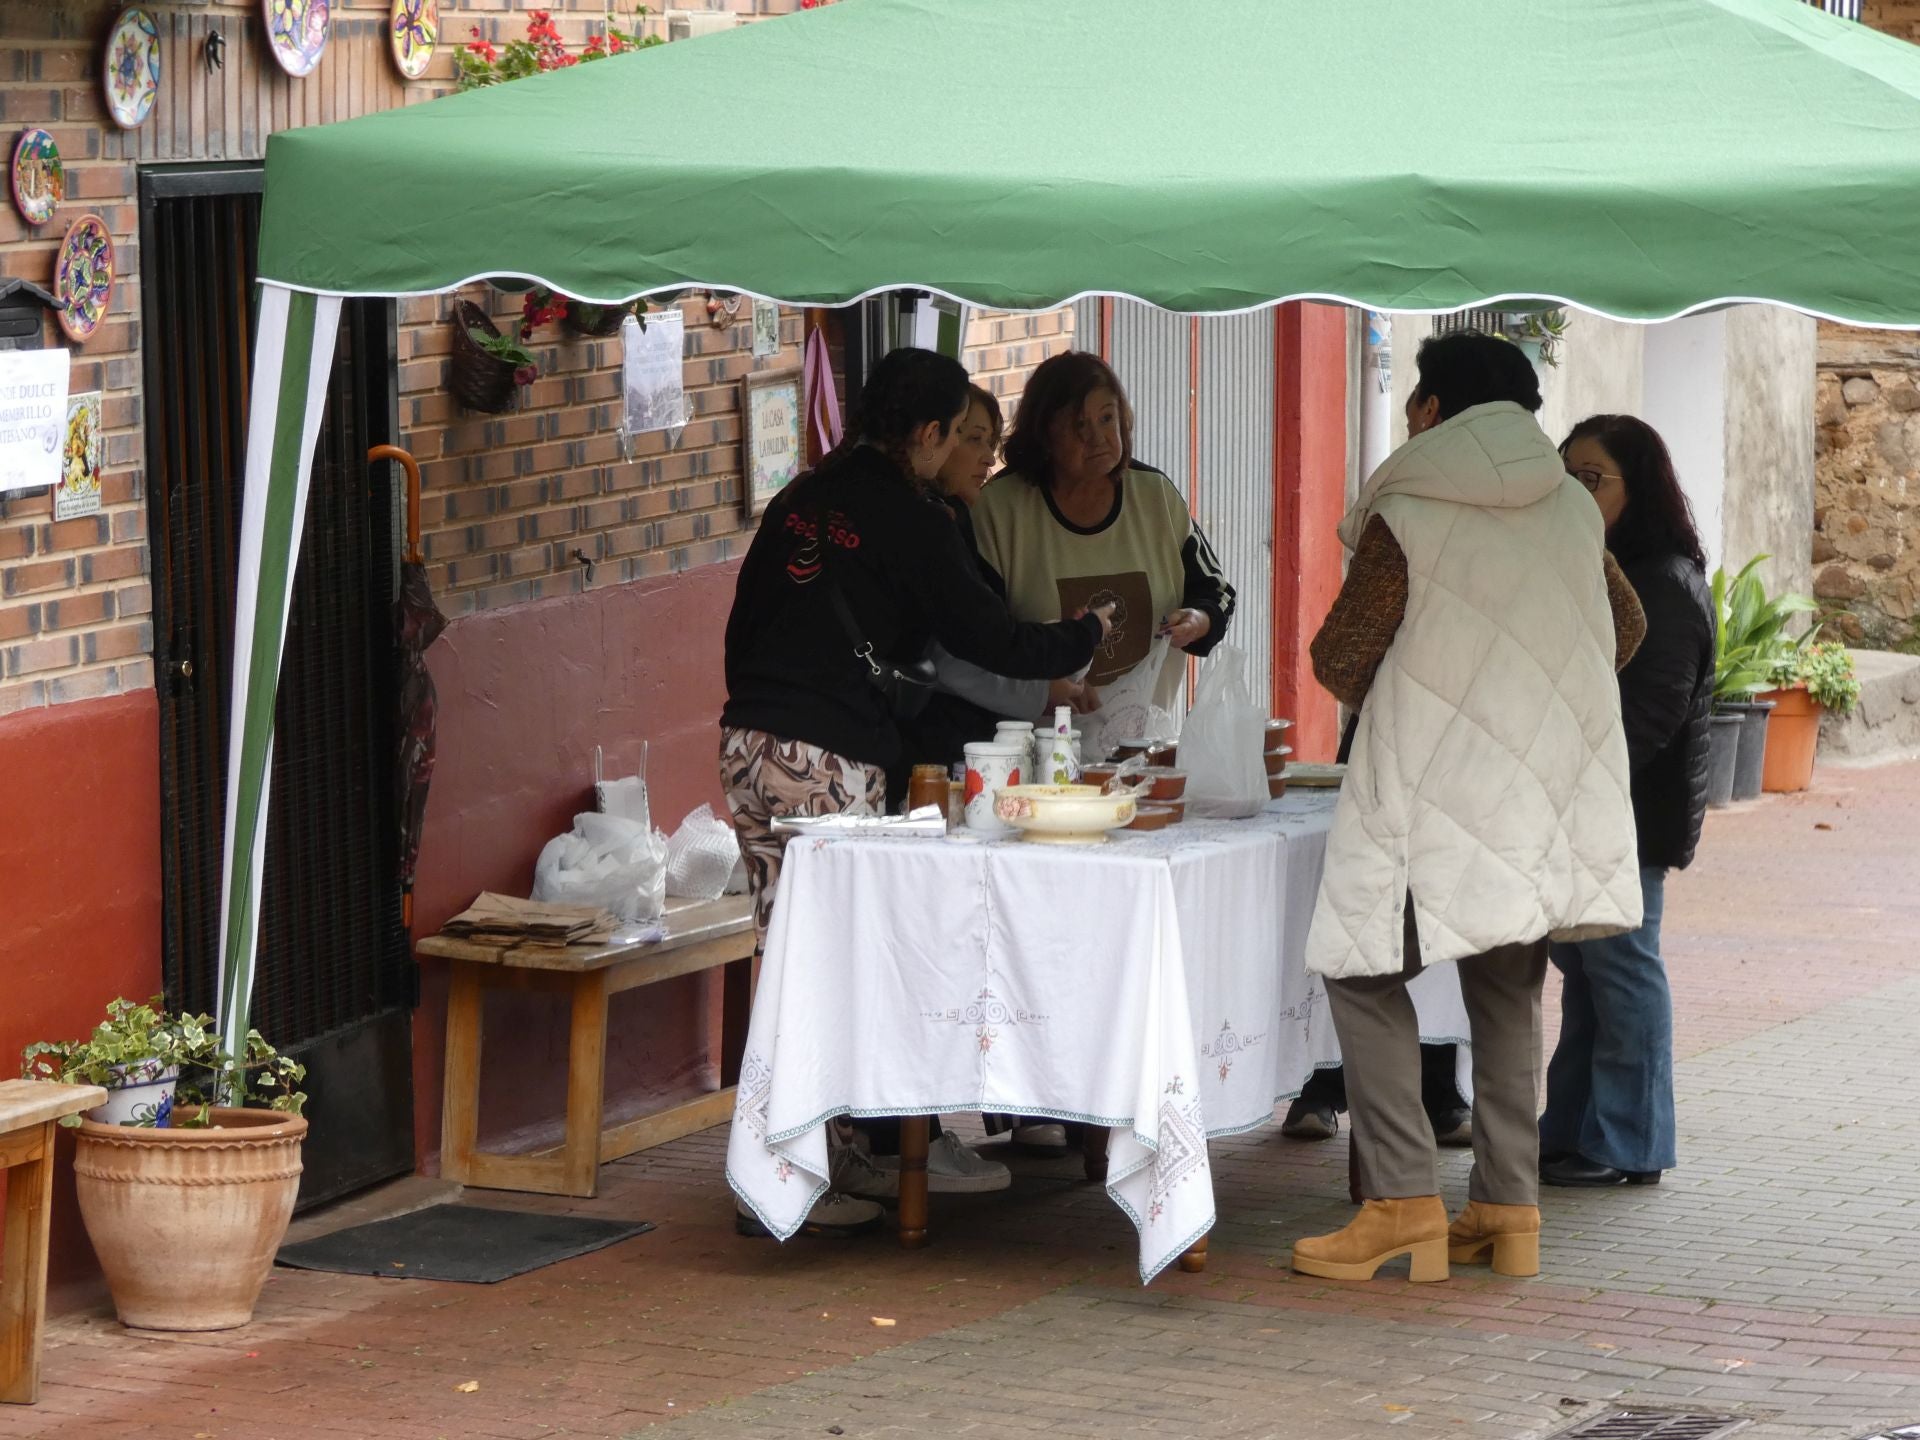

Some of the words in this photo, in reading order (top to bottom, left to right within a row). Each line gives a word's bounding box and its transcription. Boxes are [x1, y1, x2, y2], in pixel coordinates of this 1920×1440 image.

[18, 383, 56, 399] DULCE
[762, 412, 770, 429] LA
[770, 408, 784, 427] CASA
[759, 440, 767, 458] LA
[766, 435, 789, 456] PAULINA
